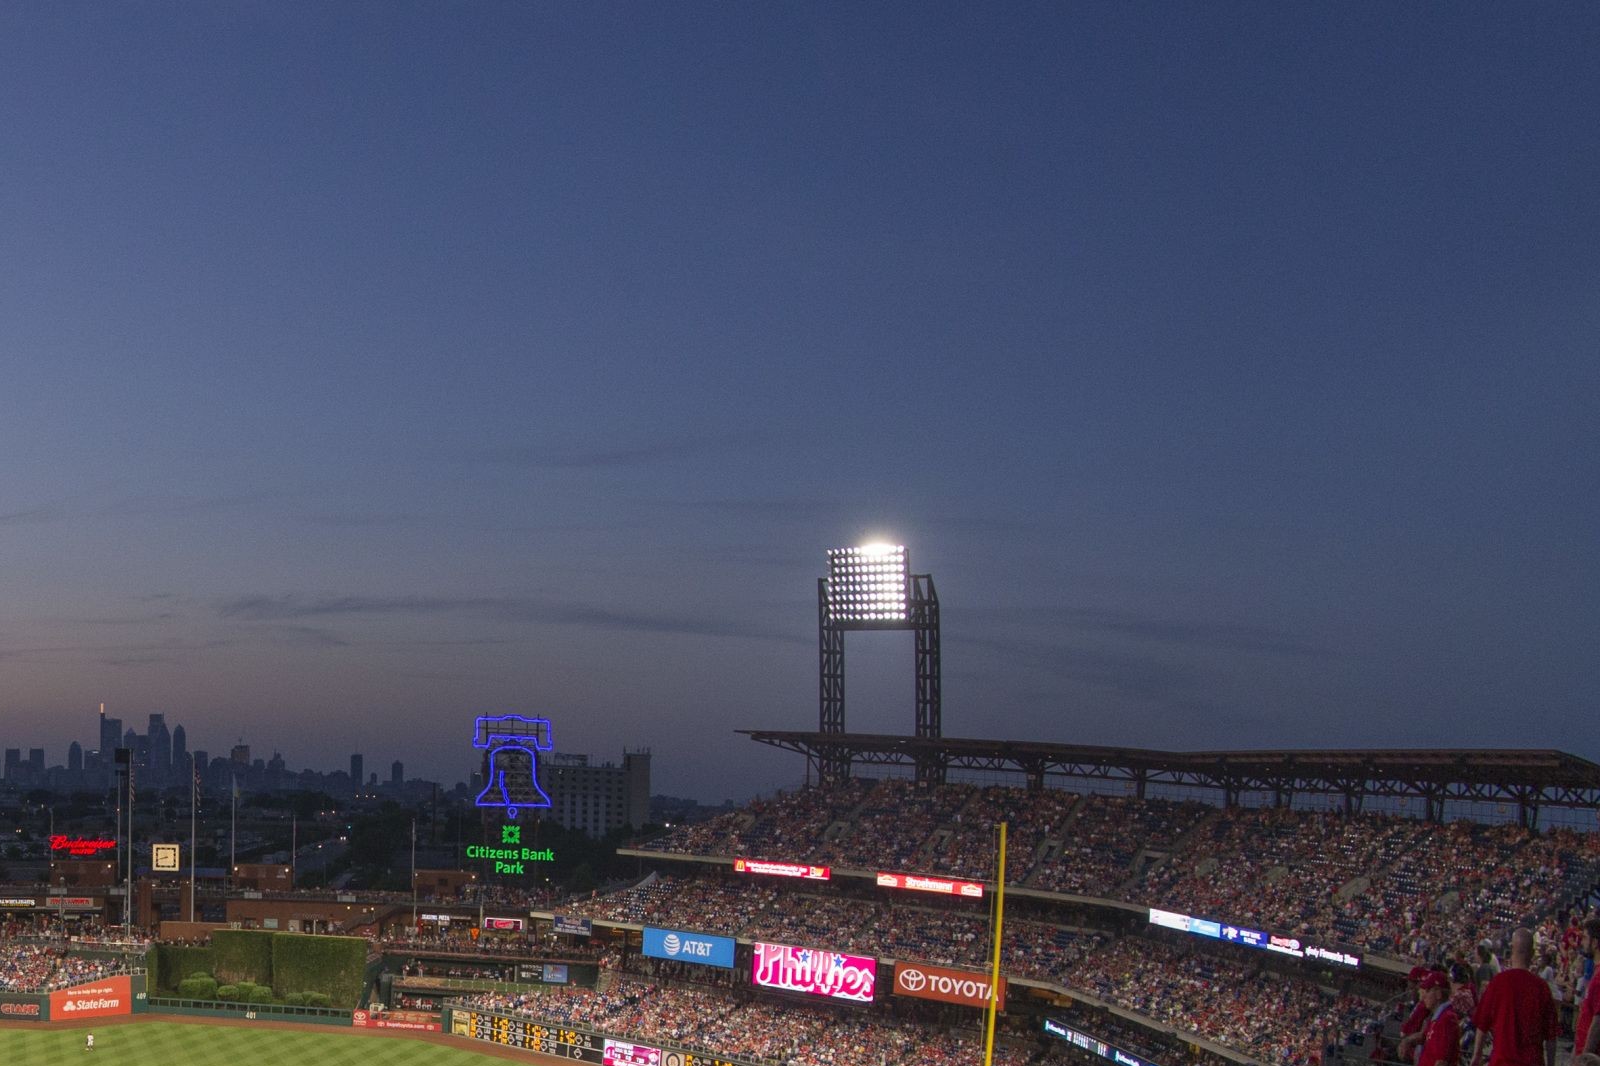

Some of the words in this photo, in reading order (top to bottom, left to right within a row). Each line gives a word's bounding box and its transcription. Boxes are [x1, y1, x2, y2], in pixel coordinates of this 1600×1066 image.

[50, 834, 116, 850] Budweiser
[466, 845, 519, 860] Citizens
[521, 848, 555, 861] Bank
[495, 861, 524, 874] Park
[682, 940, 713, 957] AT&T
[756, 943, 875, 1000] Phillies
[928, 974, 1001, 1001] TOYOTA
[1, 1003, 40, 1015] GIANT
